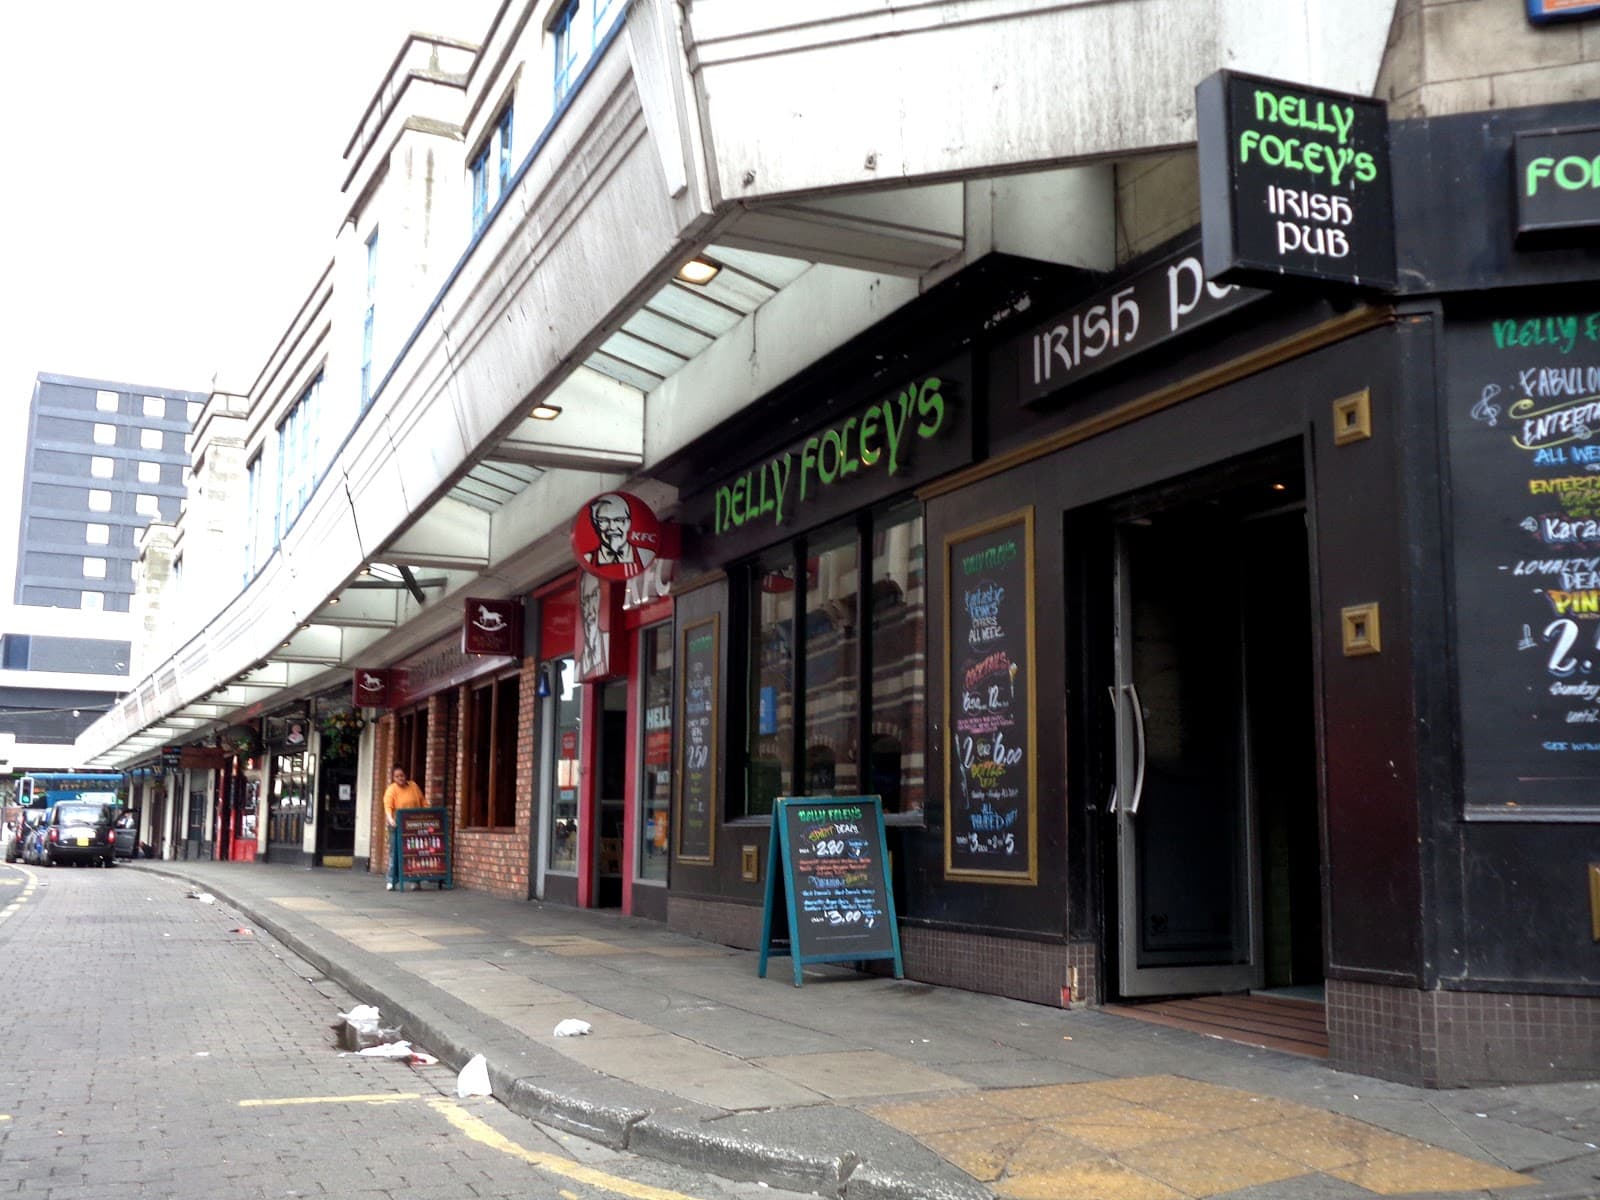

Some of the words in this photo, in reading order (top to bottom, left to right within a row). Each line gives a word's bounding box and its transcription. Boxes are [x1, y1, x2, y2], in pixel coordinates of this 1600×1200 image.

[1254, 90, 1354, 144] NELLY
[1240, 130, 1377, 186] FOLEY'S
[1268, 184, 1353, 225] IRISH
[1277, 220, 1350, 257] PUB
[1033, 286, 1140, 384] IRISH
[1519, 366, 1600, 397] FABULO
[715, 452, 791, 535] NELLY
[800, 377, 944, 501] FOLEY'S
[1533, 447, 1568, 464] ALL
[631, 531, 656, 543] KFC
[1543, 518, 1600, 542] Kara
[1547, 589, 1600, 614] PIN
